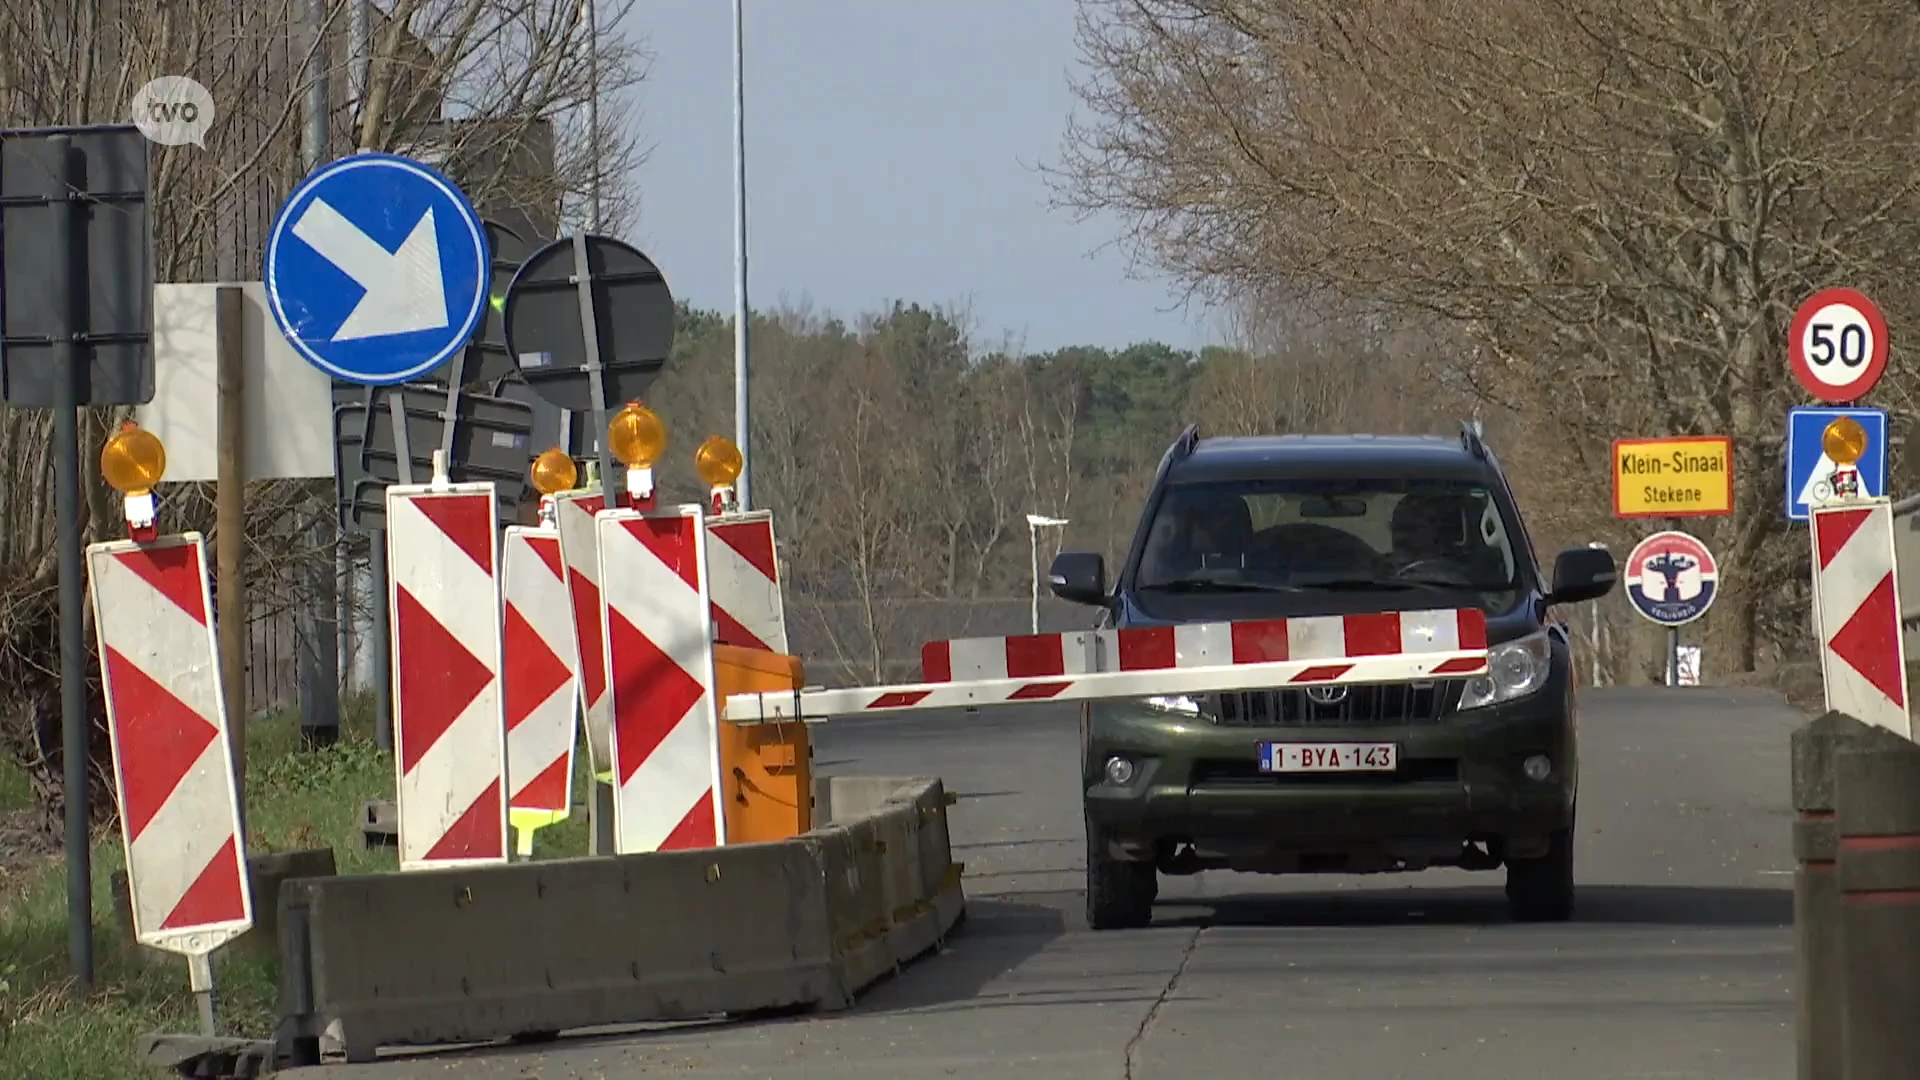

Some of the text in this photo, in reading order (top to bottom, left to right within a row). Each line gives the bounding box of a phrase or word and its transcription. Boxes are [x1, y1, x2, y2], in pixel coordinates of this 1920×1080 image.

[1811, 323, 1865, 367] 50
[1622, 451, 1723, 474] Klein-Sinaai
[1644, 486, 1701, 503] Stekene
